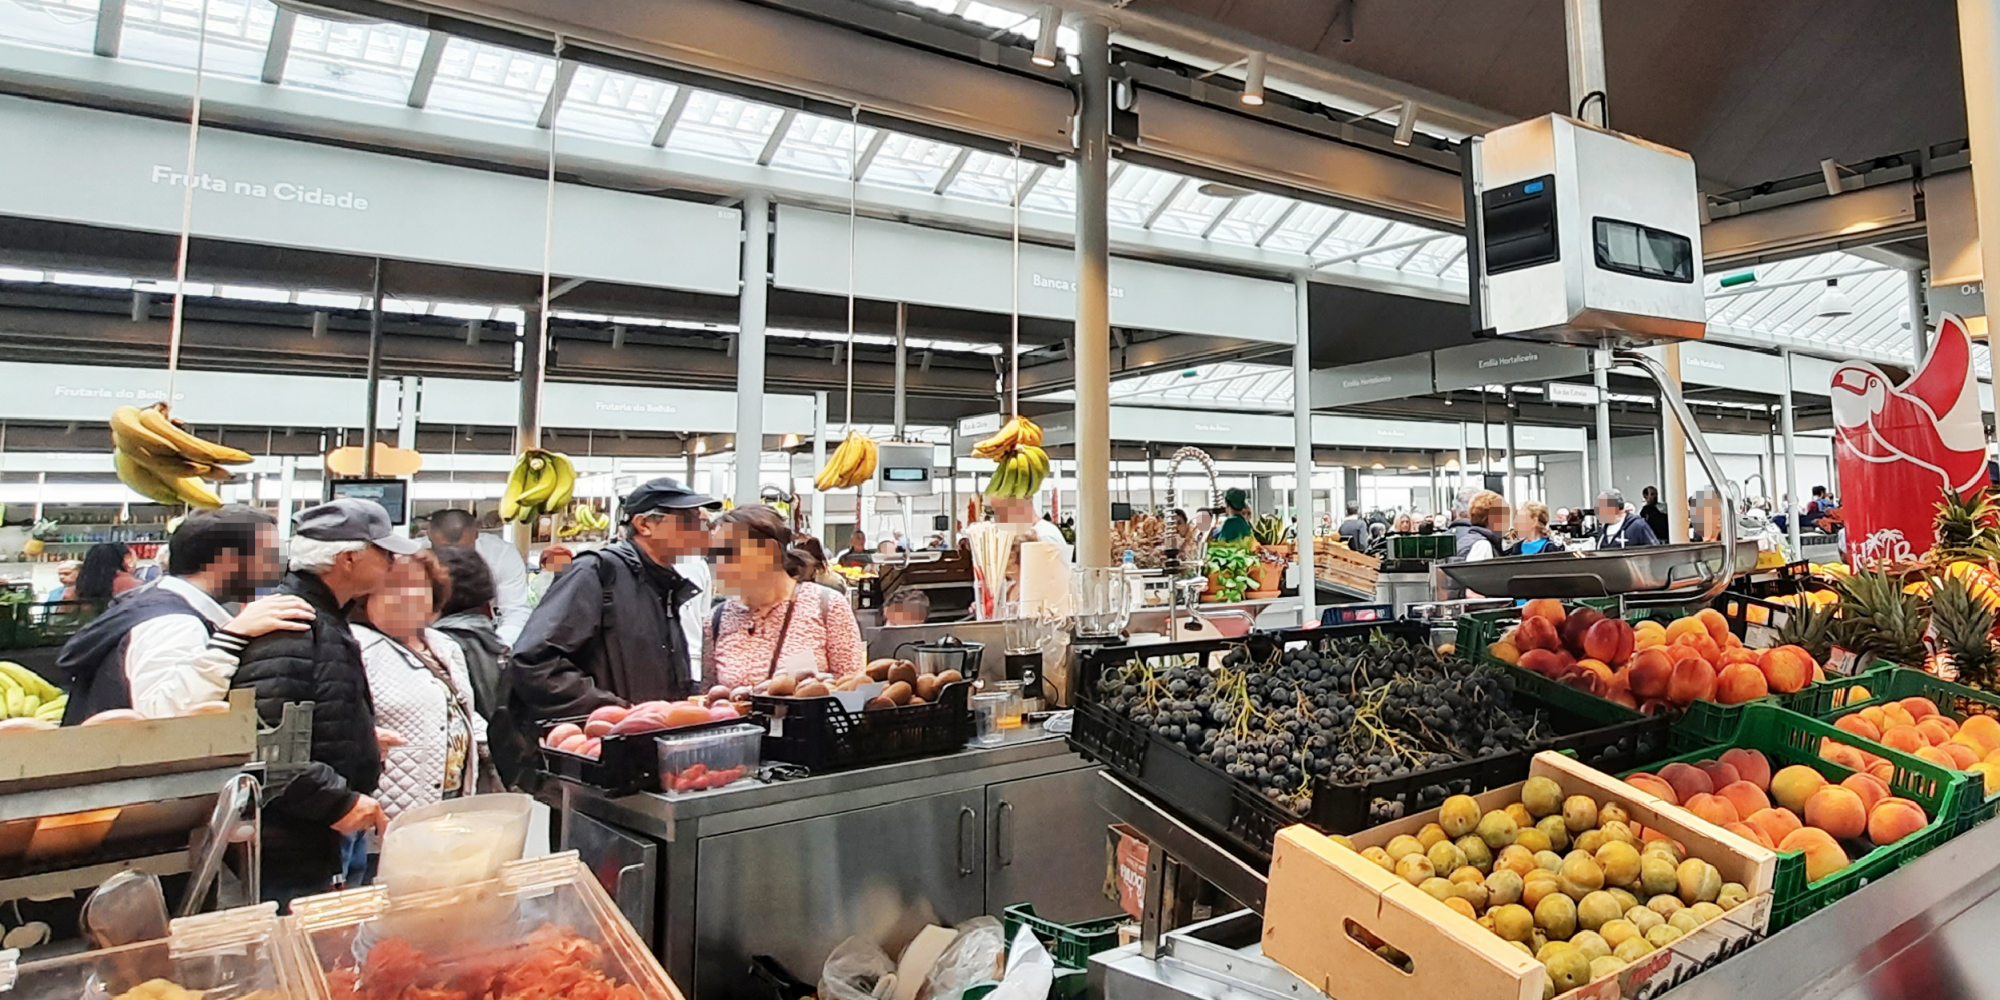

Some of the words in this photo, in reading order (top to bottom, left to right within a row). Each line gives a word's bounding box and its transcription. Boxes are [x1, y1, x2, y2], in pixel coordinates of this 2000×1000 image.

[152, 165, 228, 193] Fruta
[234, 181, 267, 199] na
[273, 182, 370, 211] Cidade
[1033, 274, 1069, 291] Banca
[55, 386, 113, 398] Frutaria
[115, 389, 135, 399] do
[137, 389, 185, 400] Bolho
